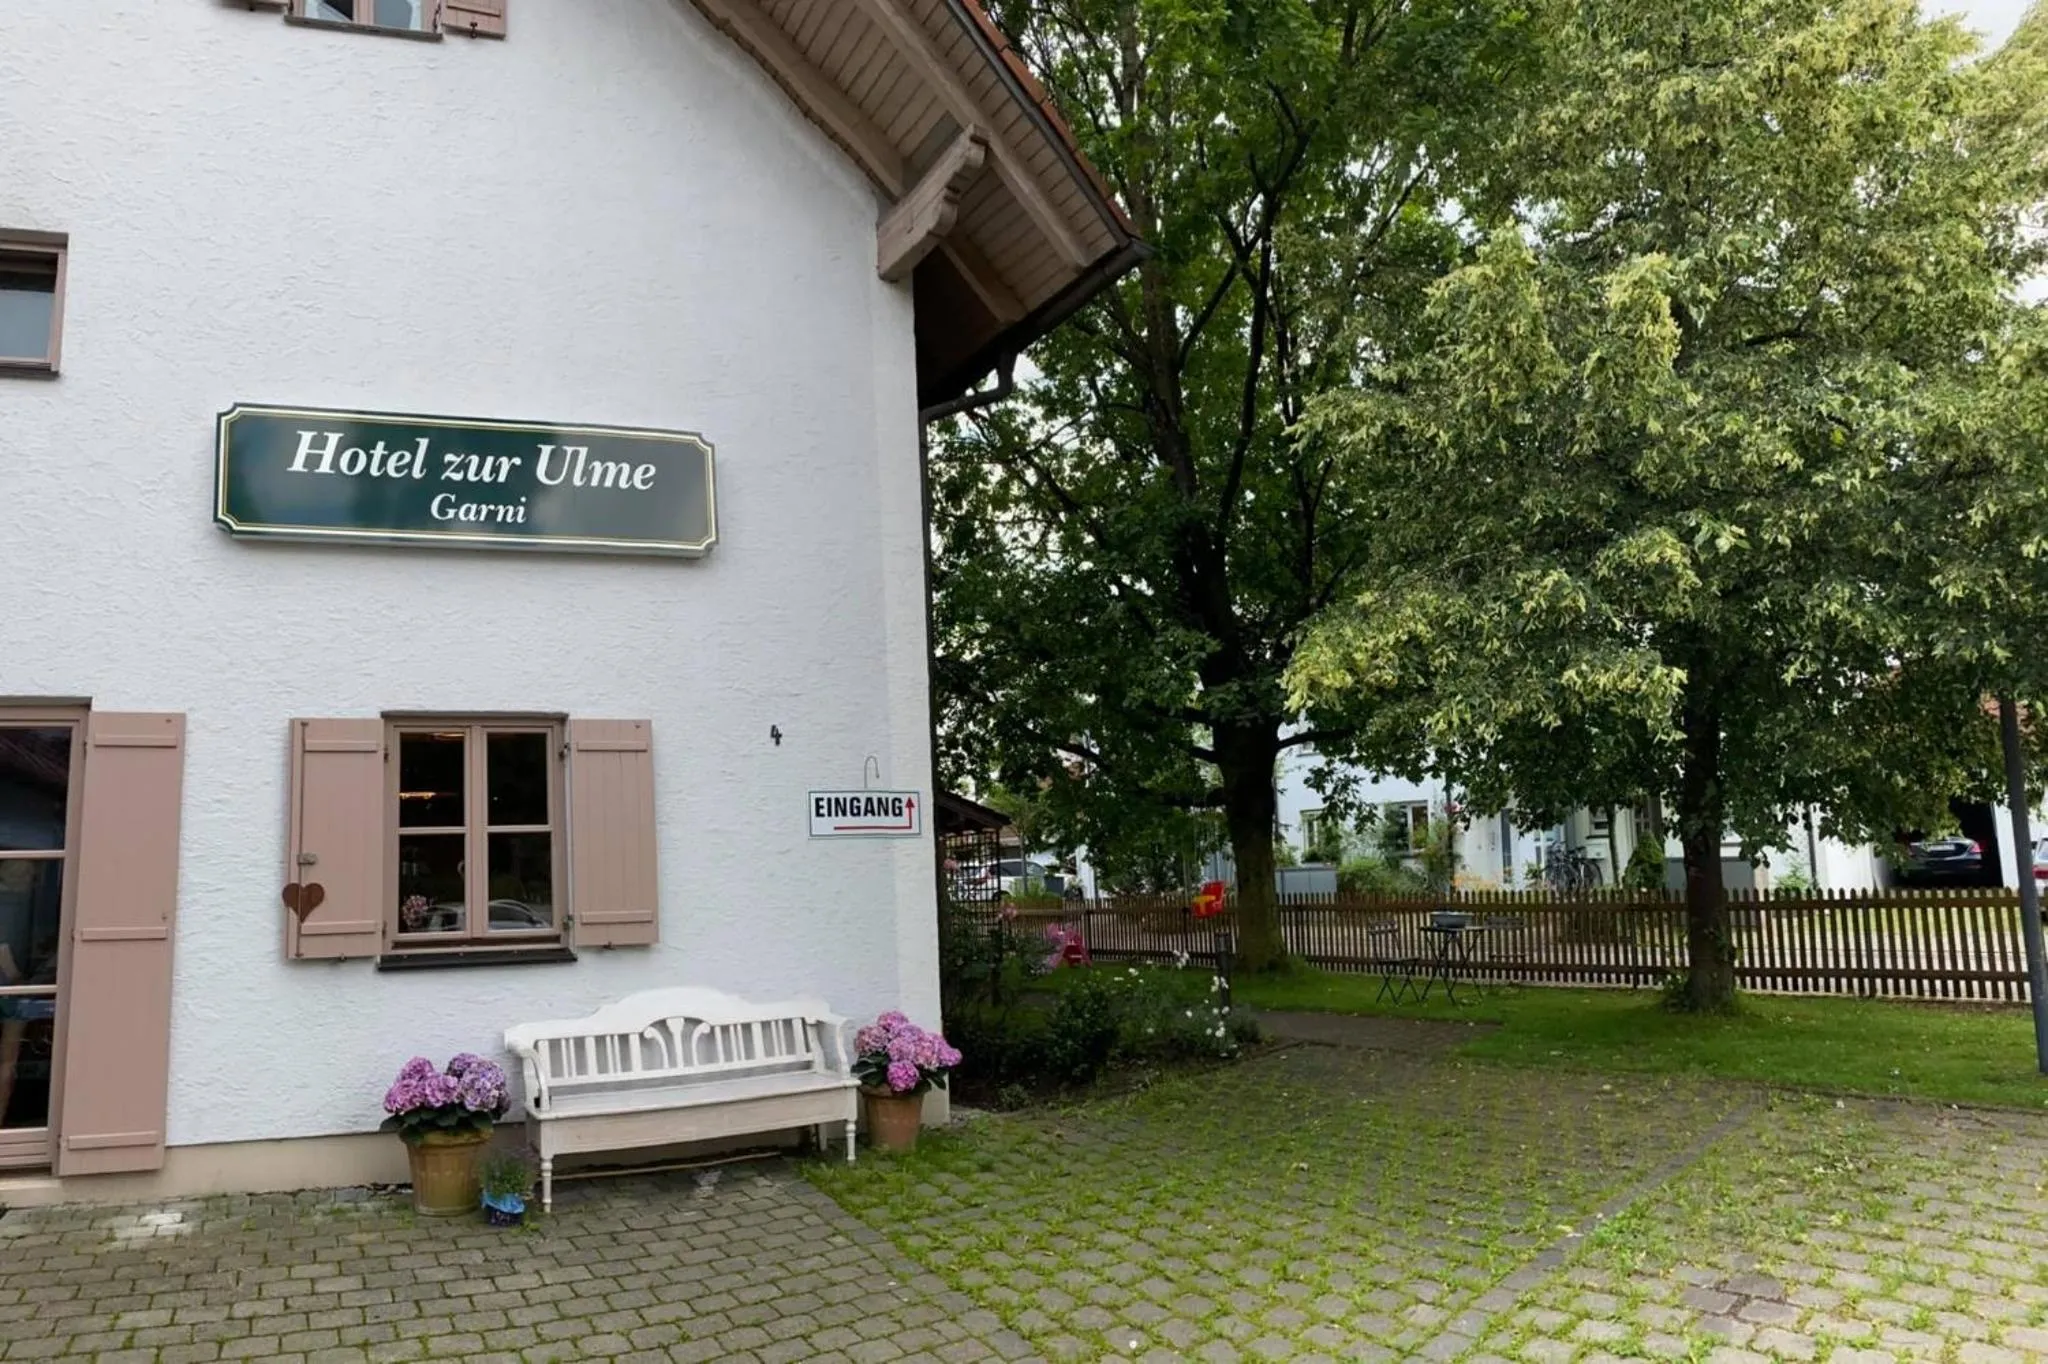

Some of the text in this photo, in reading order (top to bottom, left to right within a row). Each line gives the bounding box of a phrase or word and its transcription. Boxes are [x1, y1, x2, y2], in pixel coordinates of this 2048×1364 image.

[286, 430, 657, 490] Hotel zur Ulme
[430, 494, 527, 524] Garni
[770, 724, 783, 747] 4
[814, 796, 904, 818] EINGANG
